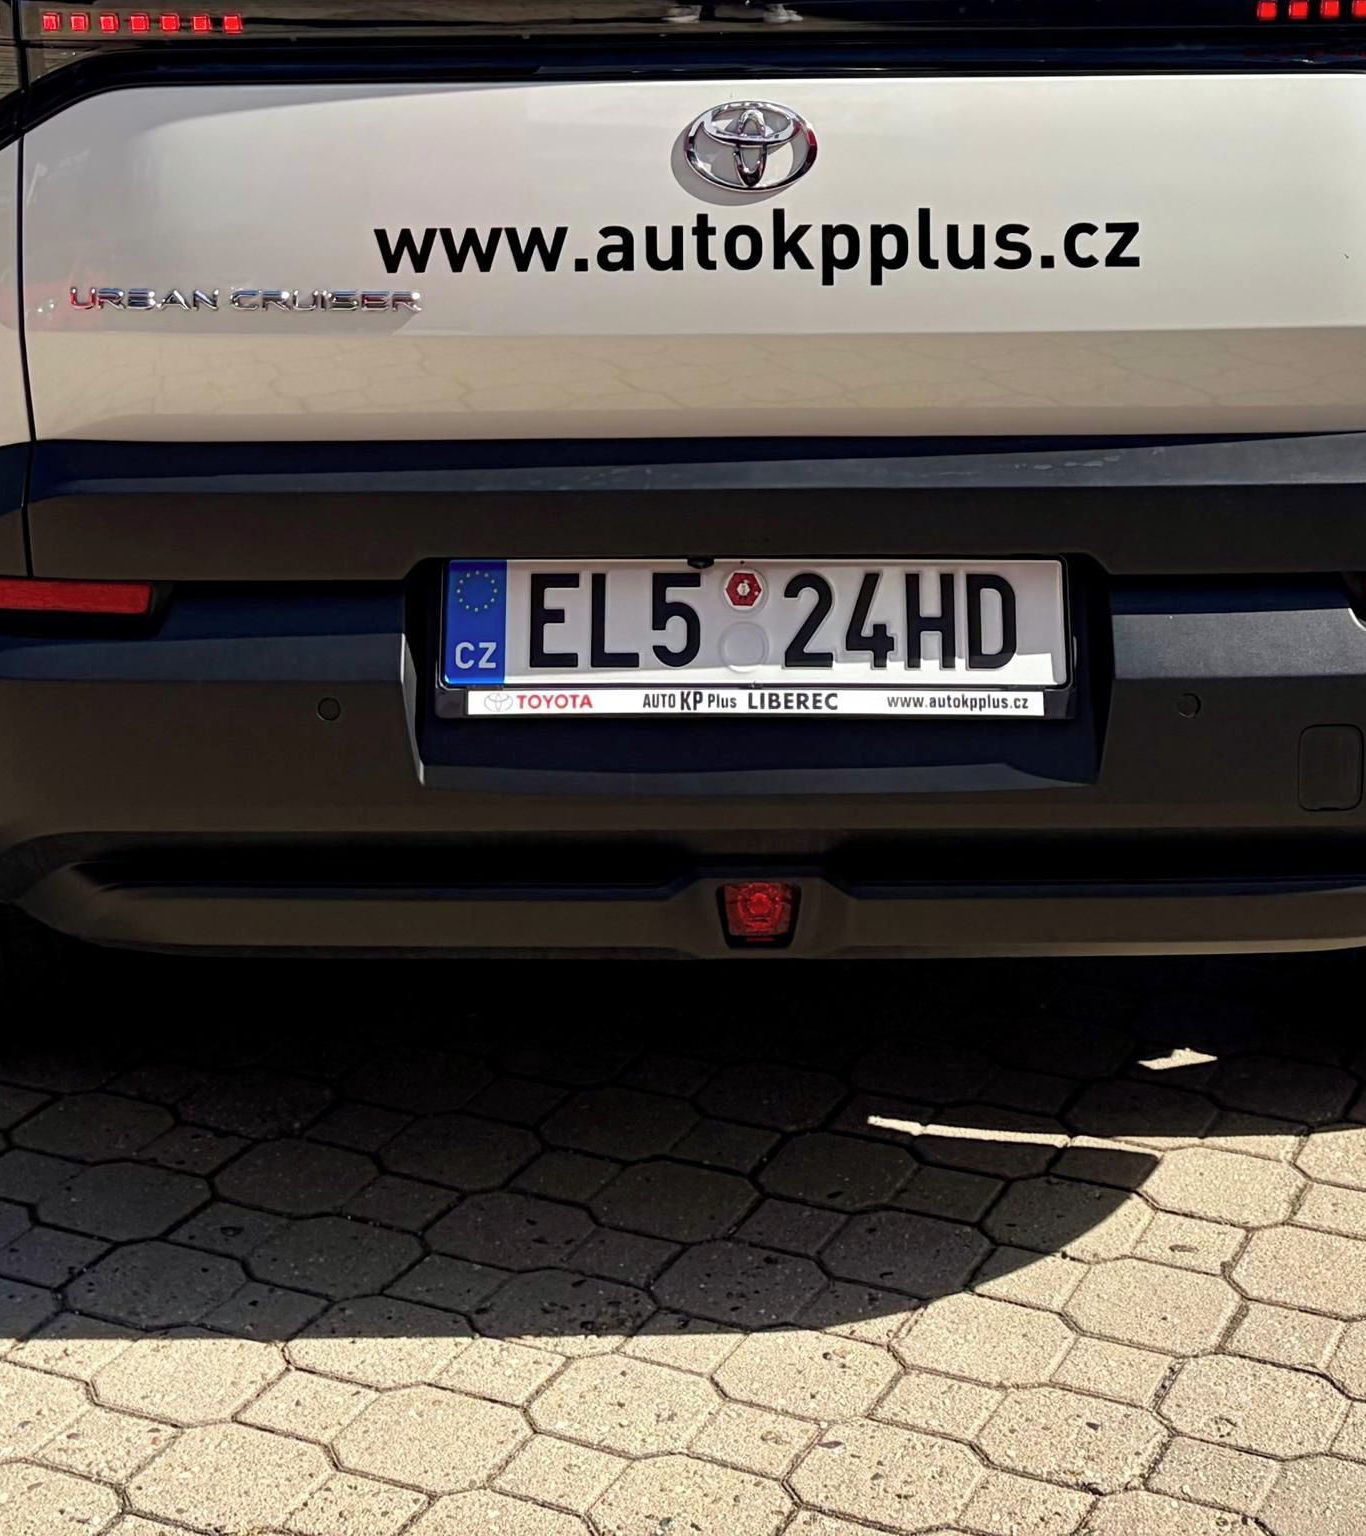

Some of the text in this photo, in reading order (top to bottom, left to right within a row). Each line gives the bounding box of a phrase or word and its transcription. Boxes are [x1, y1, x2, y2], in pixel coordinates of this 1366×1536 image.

[374, 207, 1140, 286] www.autokpplus.cz
[69, 287, 423, 312] URBAN CRUISER
[454, 572, 1017, 670] CZ EL5 24HD
[516, 691, 1029, 712] TOYOTA AUTO KP Plus LIBEREC www.autokpplus.cz
